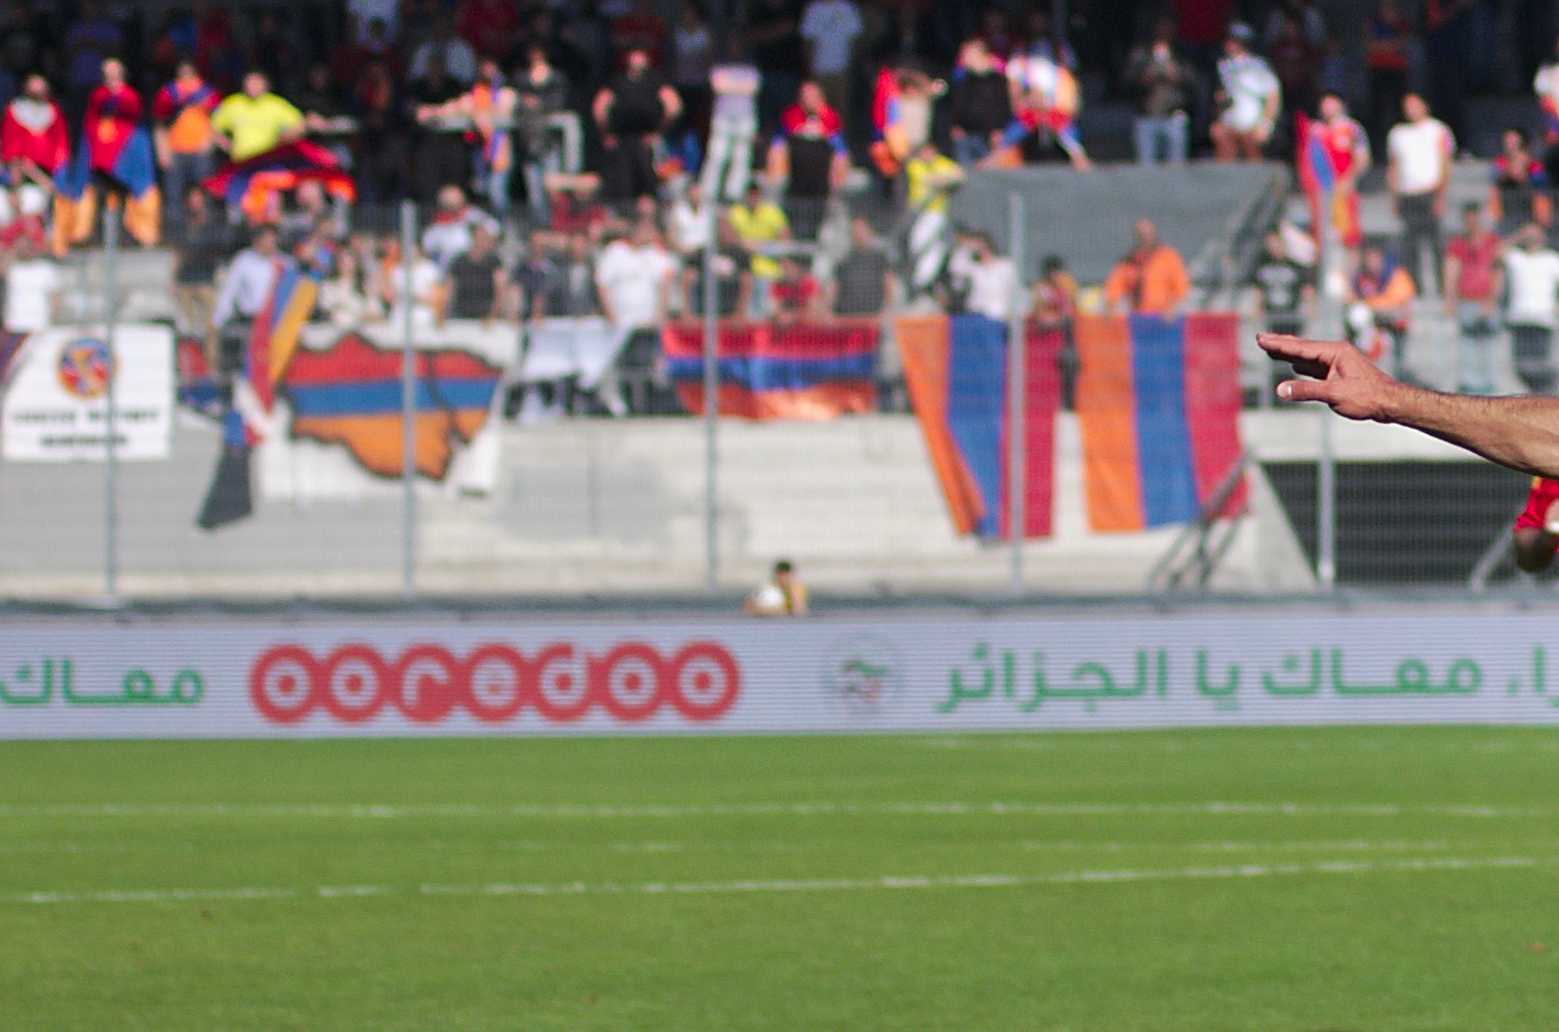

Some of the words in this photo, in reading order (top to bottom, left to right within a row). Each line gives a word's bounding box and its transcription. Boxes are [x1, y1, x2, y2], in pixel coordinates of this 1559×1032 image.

[250, 643, 741, 725] ooredoo
[935, 641, 1166, 713] الجزائر
[1195, 647, 1242, 711] يا
[1260, 645, 1483, 696] معاك
